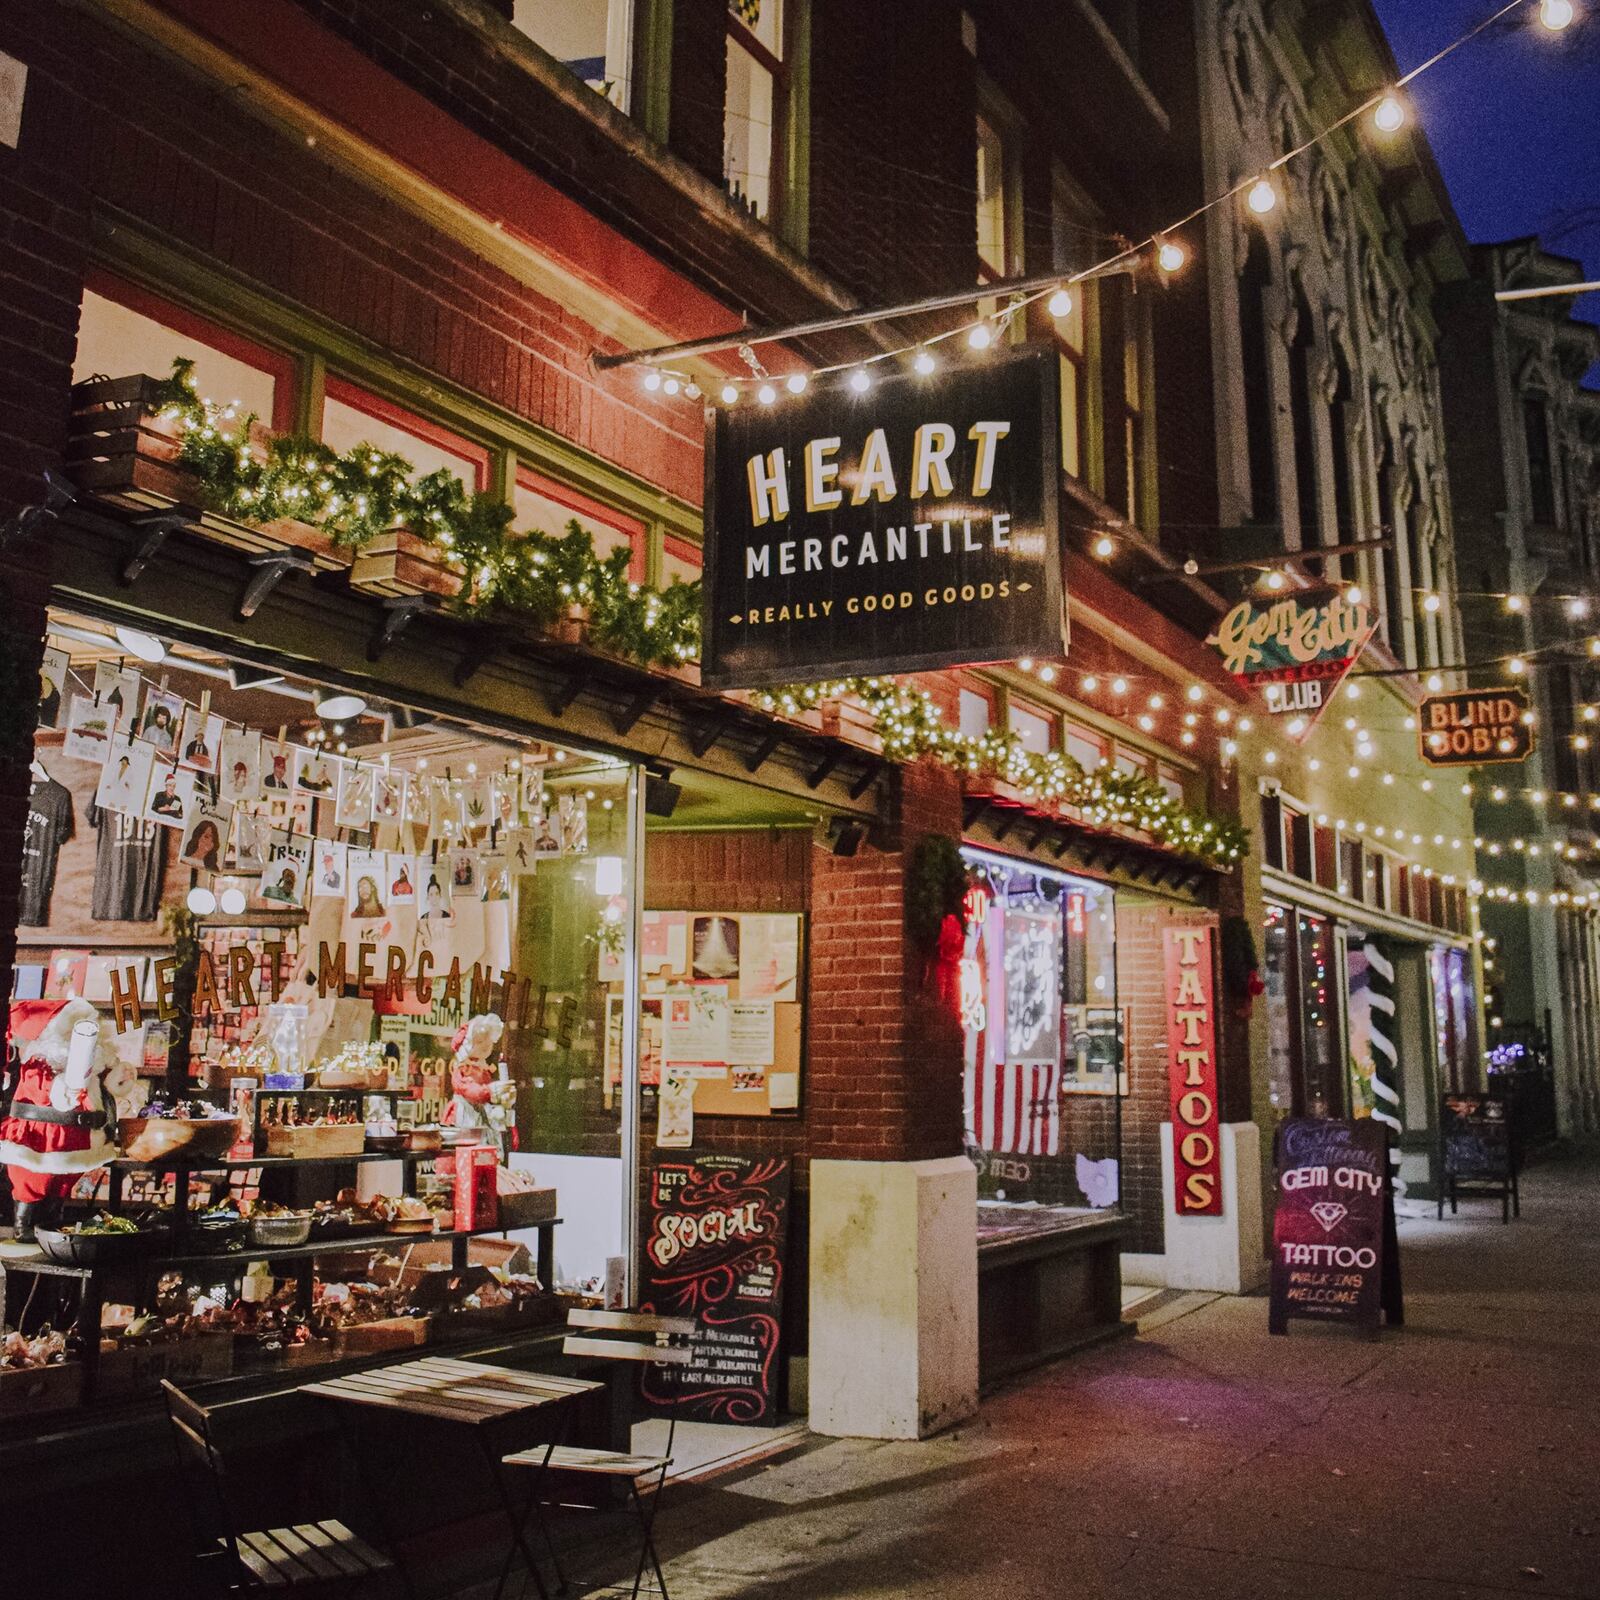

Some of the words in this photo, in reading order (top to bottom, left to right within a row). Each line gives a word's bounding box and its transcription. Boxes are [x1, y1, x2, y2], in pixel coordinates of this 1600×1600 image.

[747, 421, 1011, 527] HEART
[745, 513, 1011, 580] MERCANTILE
[748, 601, 834, 625] REALLY
[846, 591, 914, 614] GOOD
[924, 580, 1011, 606] GOODS
[1268, 680, 1323, 714] CLUB
[1430, 699, 1517, 729] BLIND
[269, 842, 307, 863] TREE!
[109, 942, 287, 1034] HEART
[1173, 929, 1215, 1210] TATTOOS
[659, 1171, 688, 1186] LET'S
[659, 1188, 673, 1201] BE
[1281, 1166, 1329, 1191] GEM
[1334, 1166, 1383, 1196] CITY
[653, 1201, 764, 1265] SOCIAL
[1281, 1242, 1377, 1269] TATTOO
[1287, 1287, 1360, 1304] WELCOME
